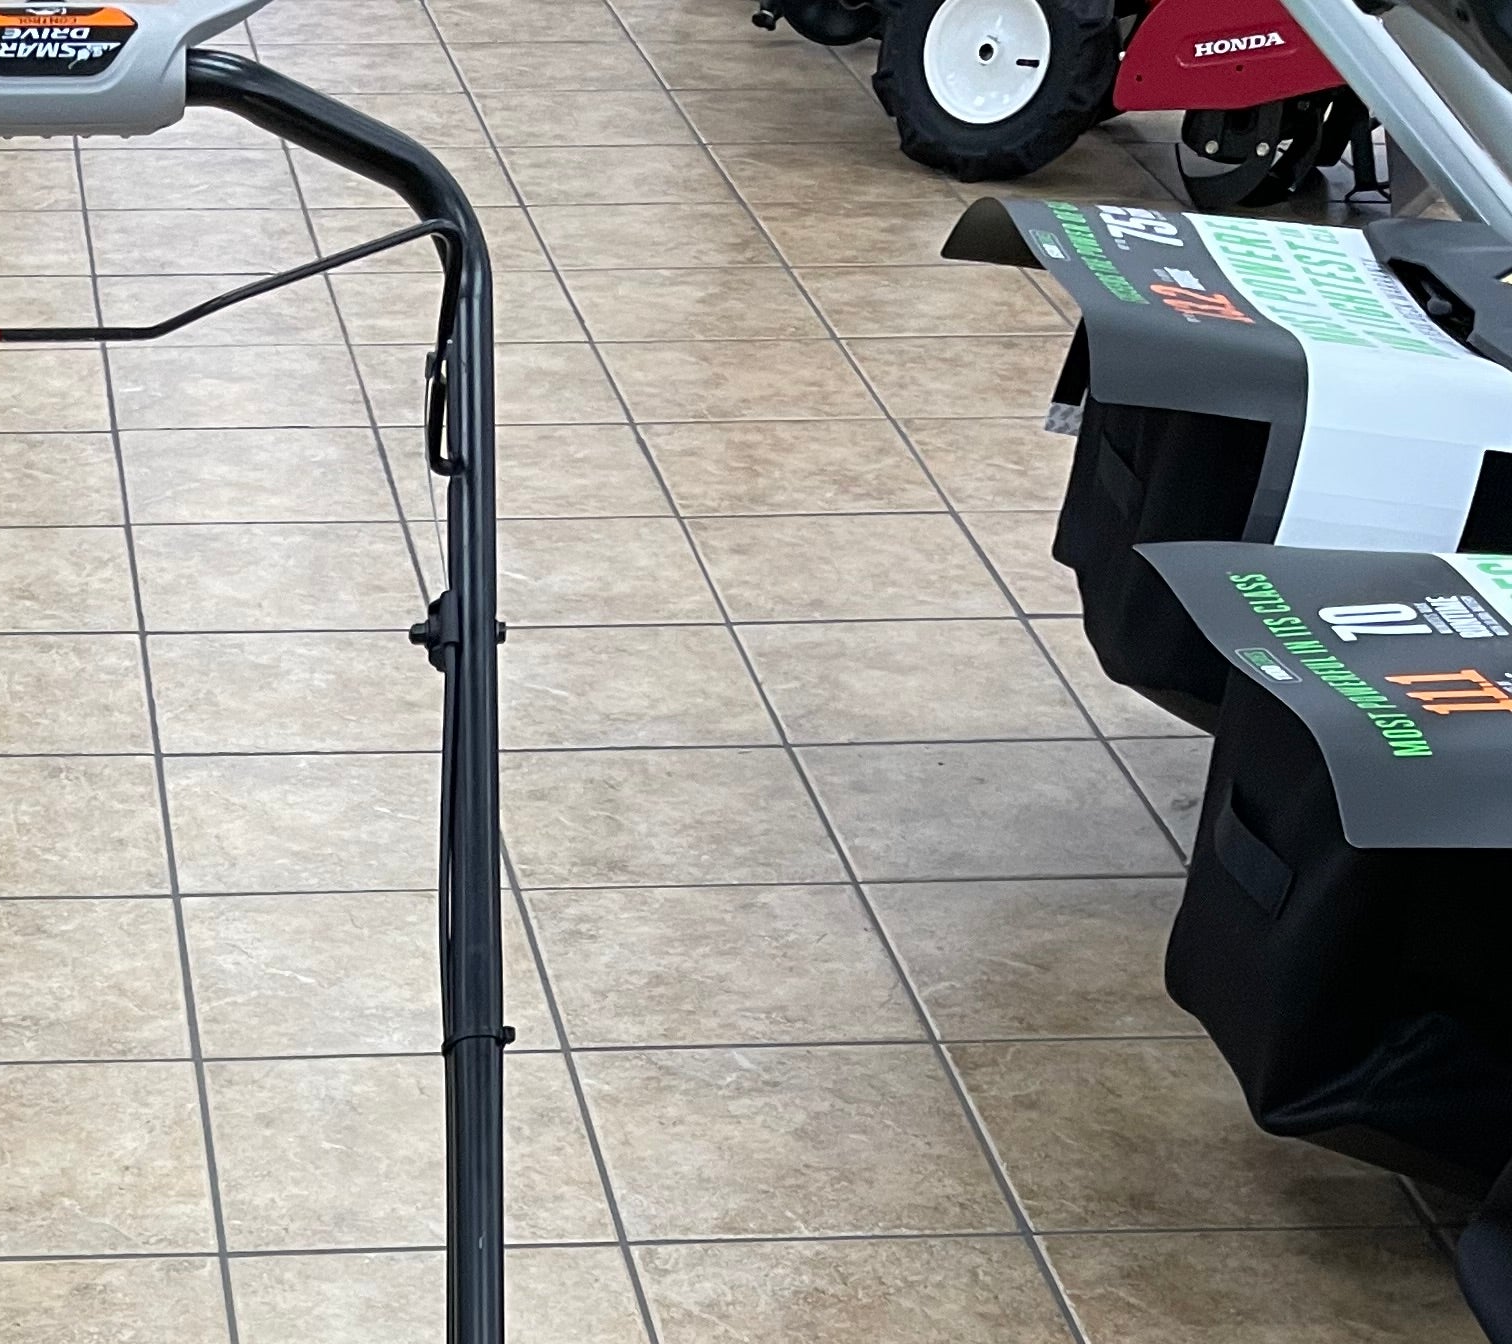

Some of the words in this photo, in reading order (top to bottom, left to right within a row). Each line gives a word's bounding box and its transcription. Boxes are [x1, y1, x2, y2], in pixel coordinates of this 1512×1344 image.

[2, 27, 90, 40] DRIVE
[1194, 32, 1286, 57] HONDA
[1229, 573, 1292, 614] CLASS
[1262, 616, 1313, 638] ITS
[1283, 640, 1329, 655] IN
[1300, 655, 1397, 709] POWERFUL
[1367, 711, 1433, 757] MOST
